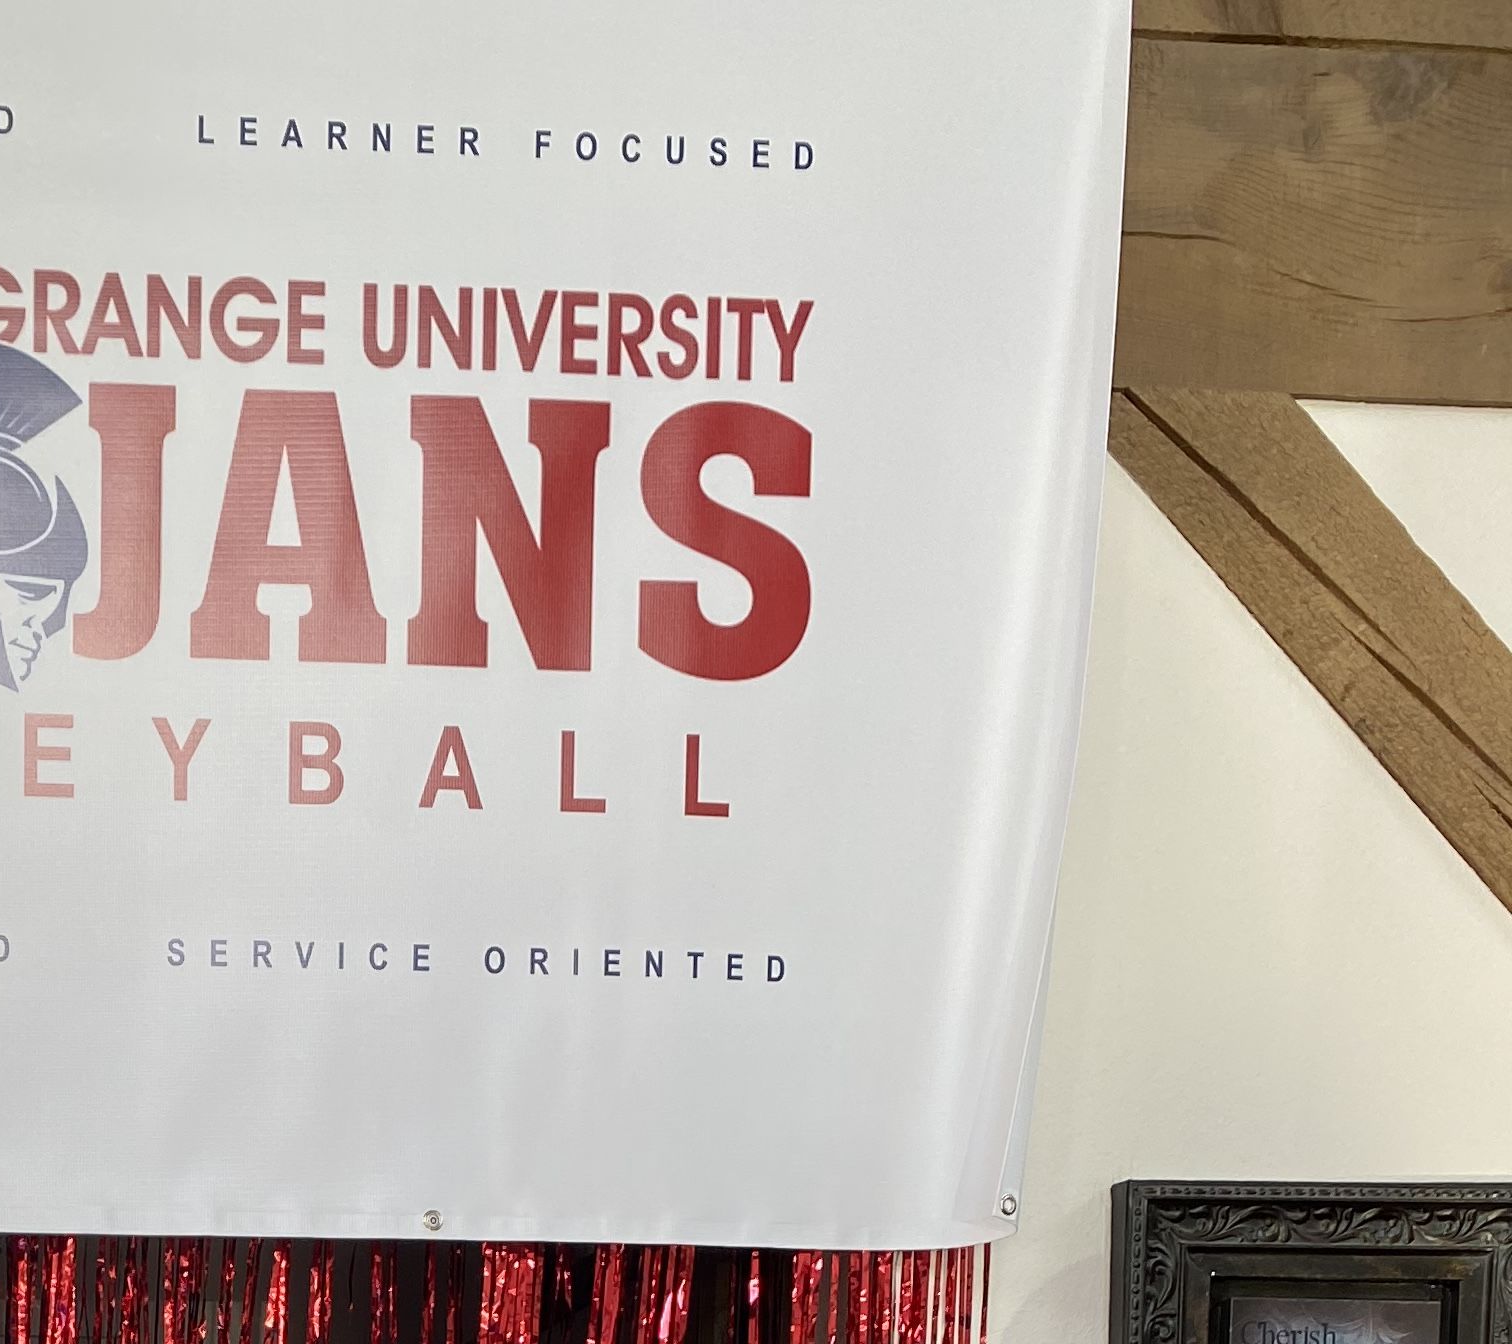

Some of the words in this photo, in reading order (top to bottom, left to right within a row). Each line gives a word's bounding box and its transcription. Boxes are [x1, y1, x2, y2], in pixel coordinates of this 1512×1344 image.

[197, 114, 480, 157] LEARNER
[533, 129, 815, 170] FOCUSED
[363, 282, 815, 383] UNIVERSITY
[166, 938, 431, 972] SERVICE
[485, 946, 785, 983] ORIENTED
